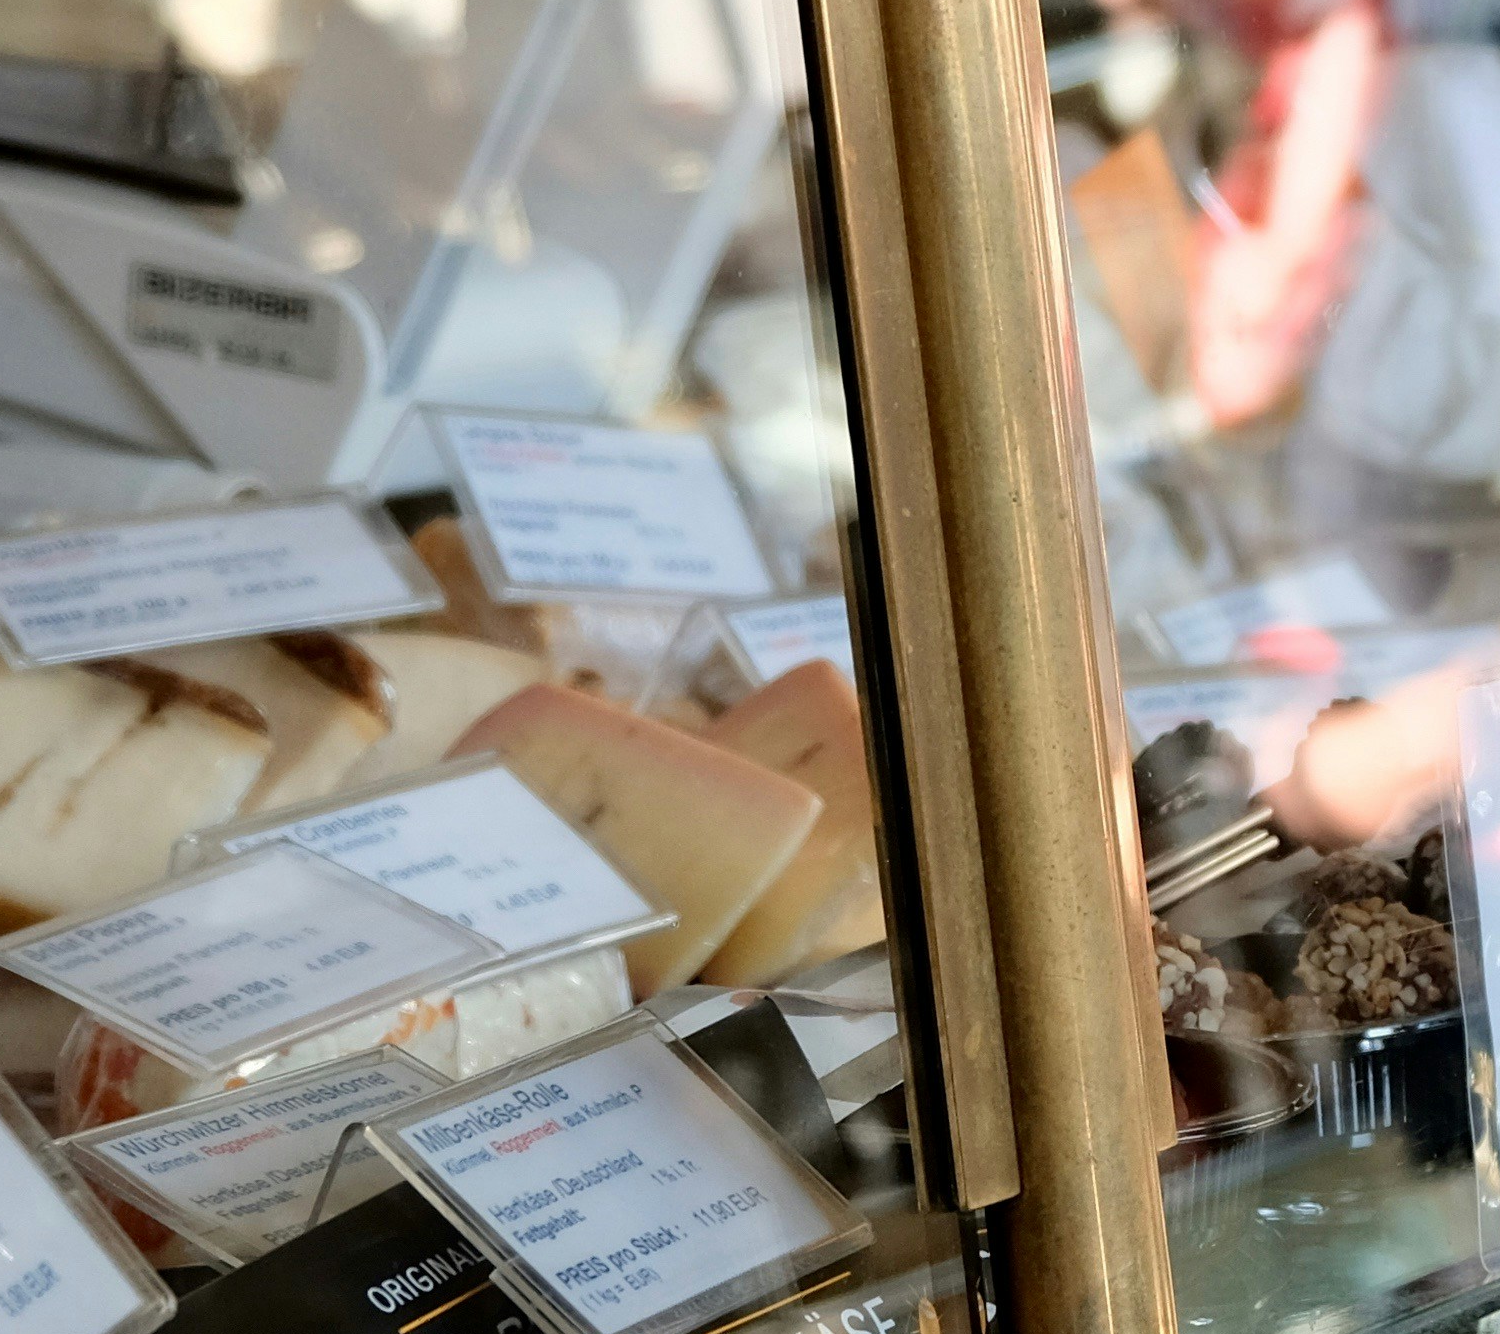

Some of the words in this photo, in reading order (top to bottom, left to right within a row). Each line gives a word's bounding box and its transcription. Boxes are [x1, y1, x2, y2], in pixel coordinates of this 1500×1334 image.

[294, 803, 408, 844] Cranberries
[528, 880, 566, 904] EUR
[156, 1001, 214, 1028] PREIS
[211, 992, 242, 1011] pro
[237, 979, 271, 997] 100
[336, 939, 373, 960] EUR
[110, 1109, 249, 1160] Würchwitzer
[247, 1069, 396, 1122] Himmelskomet
[140, 1150, 205, 1177] Kümmel,
[200, 1123, 291, 1158] Roggenmehl,
[287, 1116, 306, 1132] aus
[412, 1081, 571, 1156] Milbenkäse-Rolle
[440, 1148, 499, 1178] Kümmel,
[489, 1118, 566, 1158] Roggenmehl,
[562, 1110, 586, 1130] aus
[582, 1088, 635, 1124] Kuhmilch,
[188, 1177, 273, 1210] Hartkäse
[488, 1187, 559, 1226] Hartkäse
[555, 1149, 645, 1203] /Deutschland
[512, 1205, 588, 1248] Fettgehalt:
[555, 1252, 611, 1292] PREIS
[606, 1244, 637, 1275] pro
[631, 1222, 680, 1258] Stück
[690, 1192, 736, 1231] 11,90
[728, 1182, 771, 1215] EUR
[22, 1260, 61, 1299] EUR
[366, 1240, 488, 1315] ORIGINAL
[627, 1266, 664, 1293] EUR)
